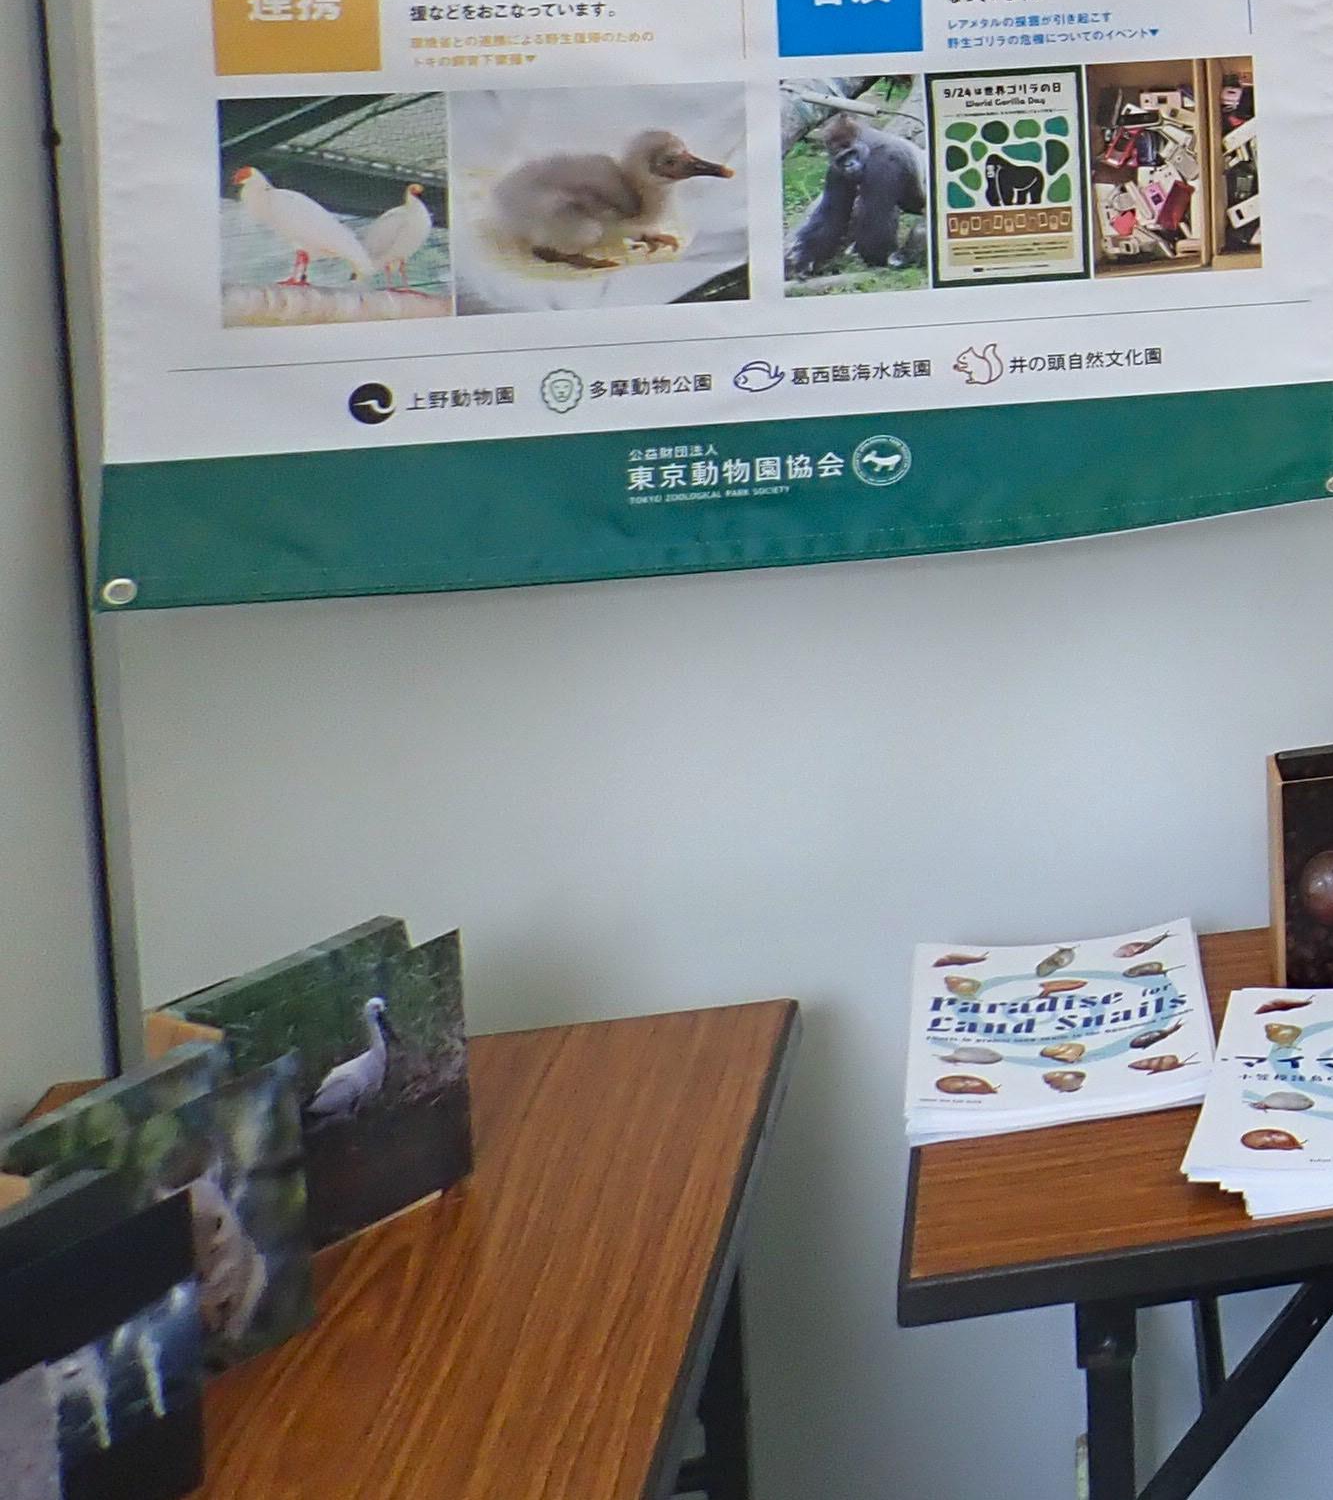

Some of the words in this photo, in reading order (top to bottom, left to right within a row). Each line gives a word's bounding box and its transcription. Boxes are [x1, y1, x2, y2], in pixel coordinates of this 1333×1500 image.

[410, 1, 617, 22] 援などをおこなっています。
[791, 359, 932, 386] 葛西臨海水族園
[1009, 347, 1163, 374] 井の頭自然文化園
[405, 385, 515, 411] 上野動物園
[588, 373, 713, 399] 多摩動物公園
[628, 443, 719, 462] 公益財団法人
[627, 451, 845, 491] 東京動物園協会
[930, 990, 1124, 1015] Paradise
[1141, 982, 1172, 998] for
[926, 1015, 1037, 1034] Land
[1055, 993, 1188, 1031] Snails
